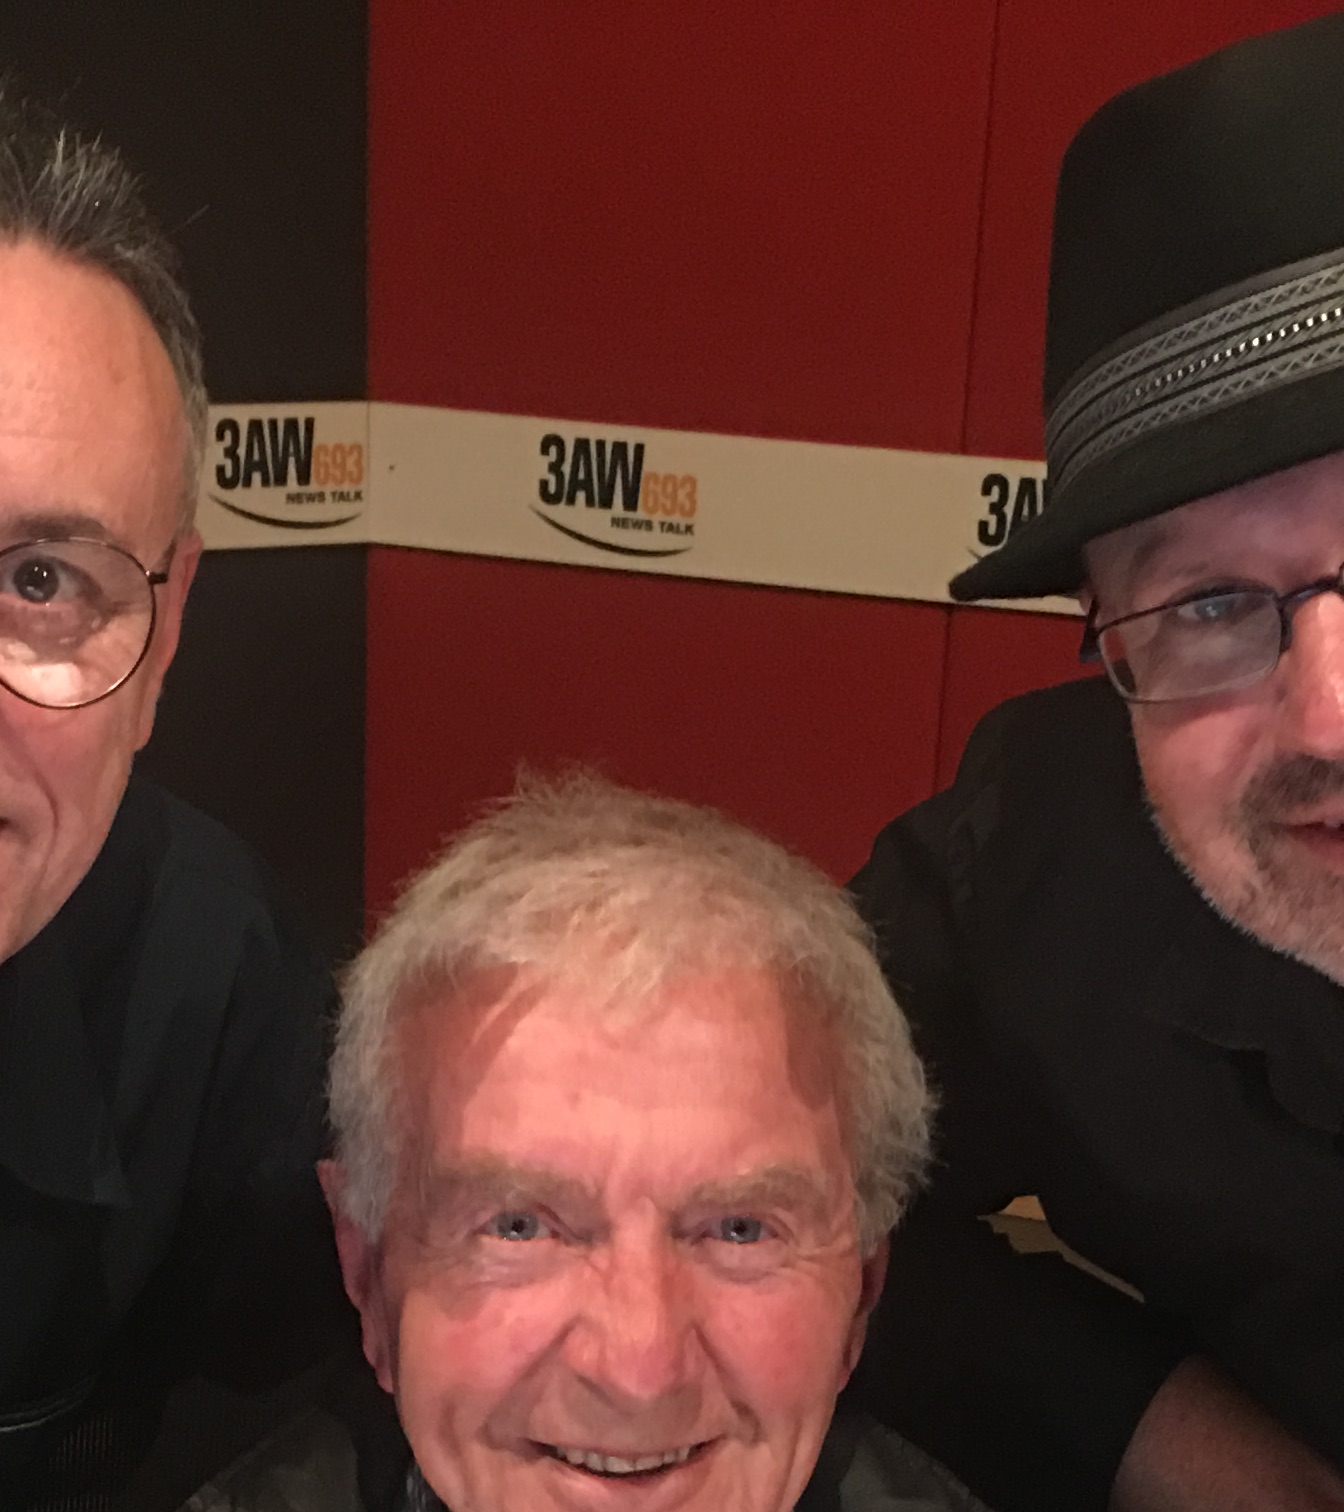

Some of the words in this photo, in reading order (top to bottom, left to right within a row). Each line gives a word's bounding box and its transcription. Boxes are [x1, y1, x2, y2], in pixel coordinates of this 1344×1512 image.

[285, 491, 326, 505] NEWS
[330, 490, 364, 503] TALK
[977, 473, 1047, 547] 3A
[610, 516, 654, 532] NEWS
[658, 520, 695, 536] TALK
